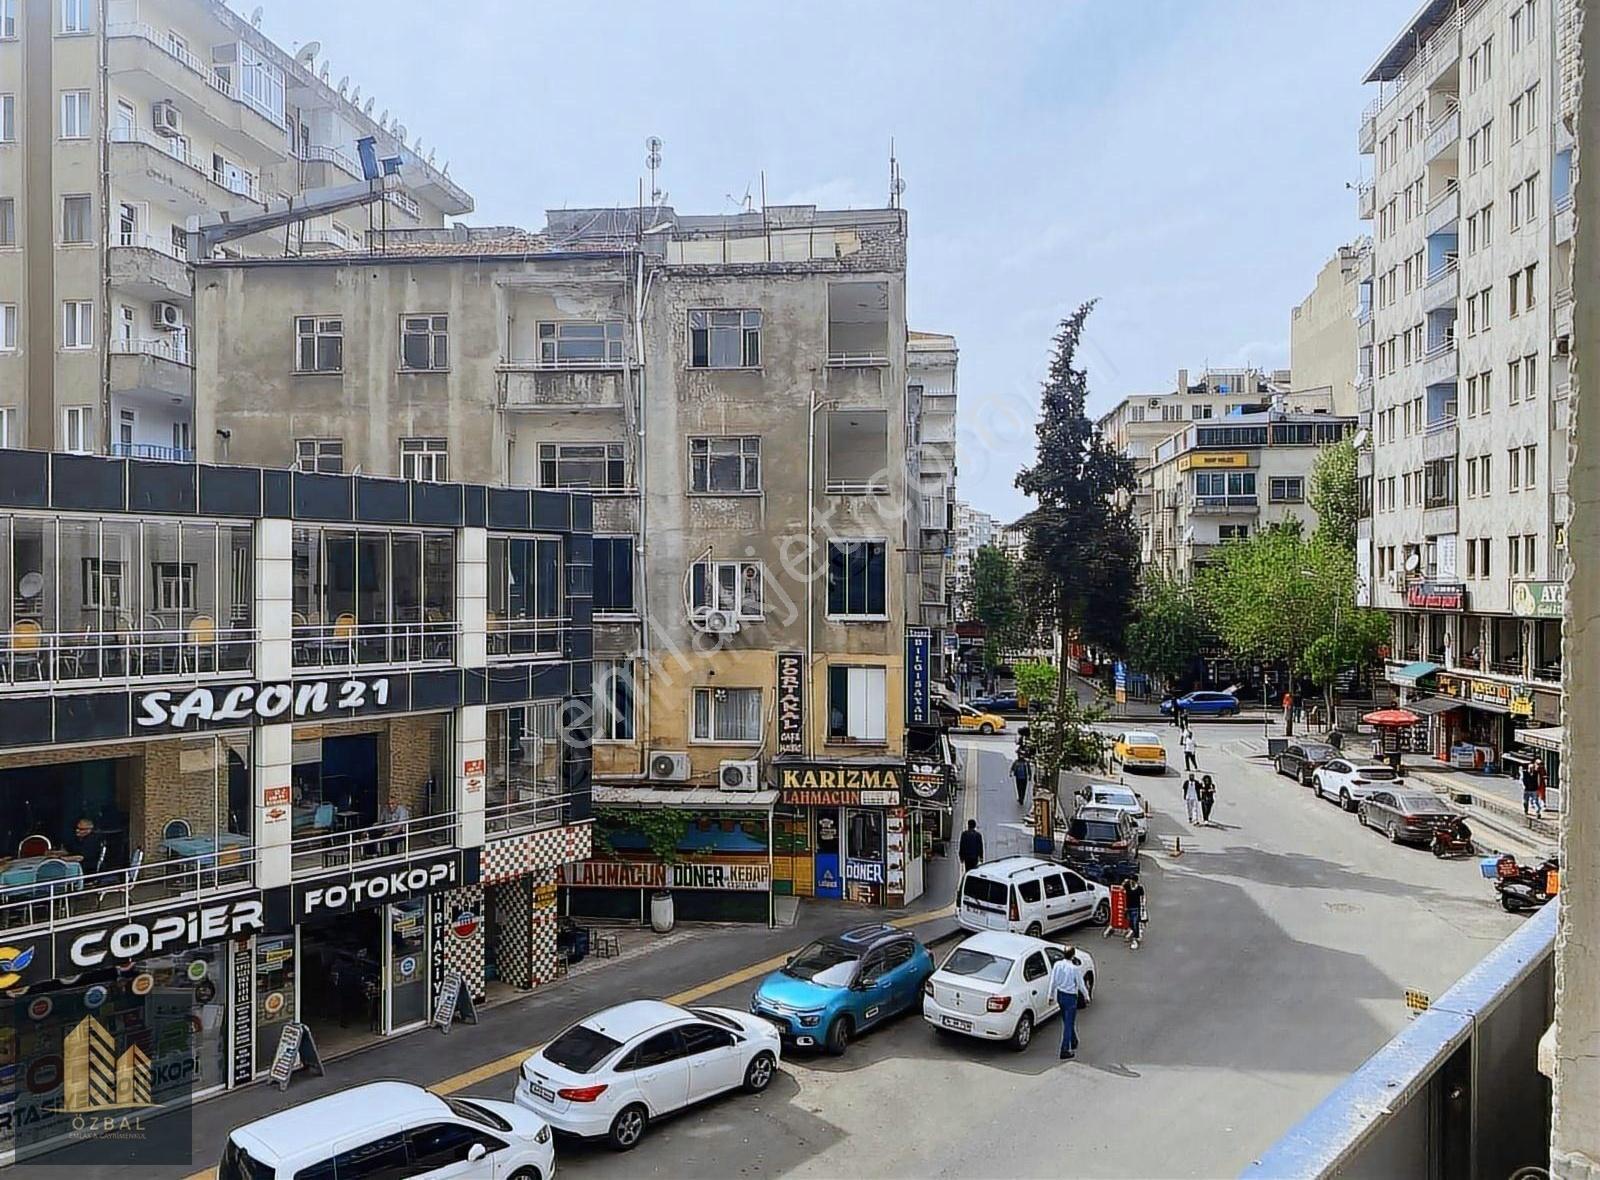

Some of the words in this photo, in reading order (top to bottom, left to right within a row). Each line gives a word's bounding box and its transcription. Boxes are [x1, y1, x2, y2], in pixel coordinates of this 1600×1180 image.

[137, 683, 328, 727] SALON
[338, 678, 389, 709] 21
[780, 658, 800, 730] PORTAKAL
[783, 790, 860, 805] LAHMACUN
[573, 864, 667, 887] LAHMACUN
[730, 866, 769, 883] KEBAP
